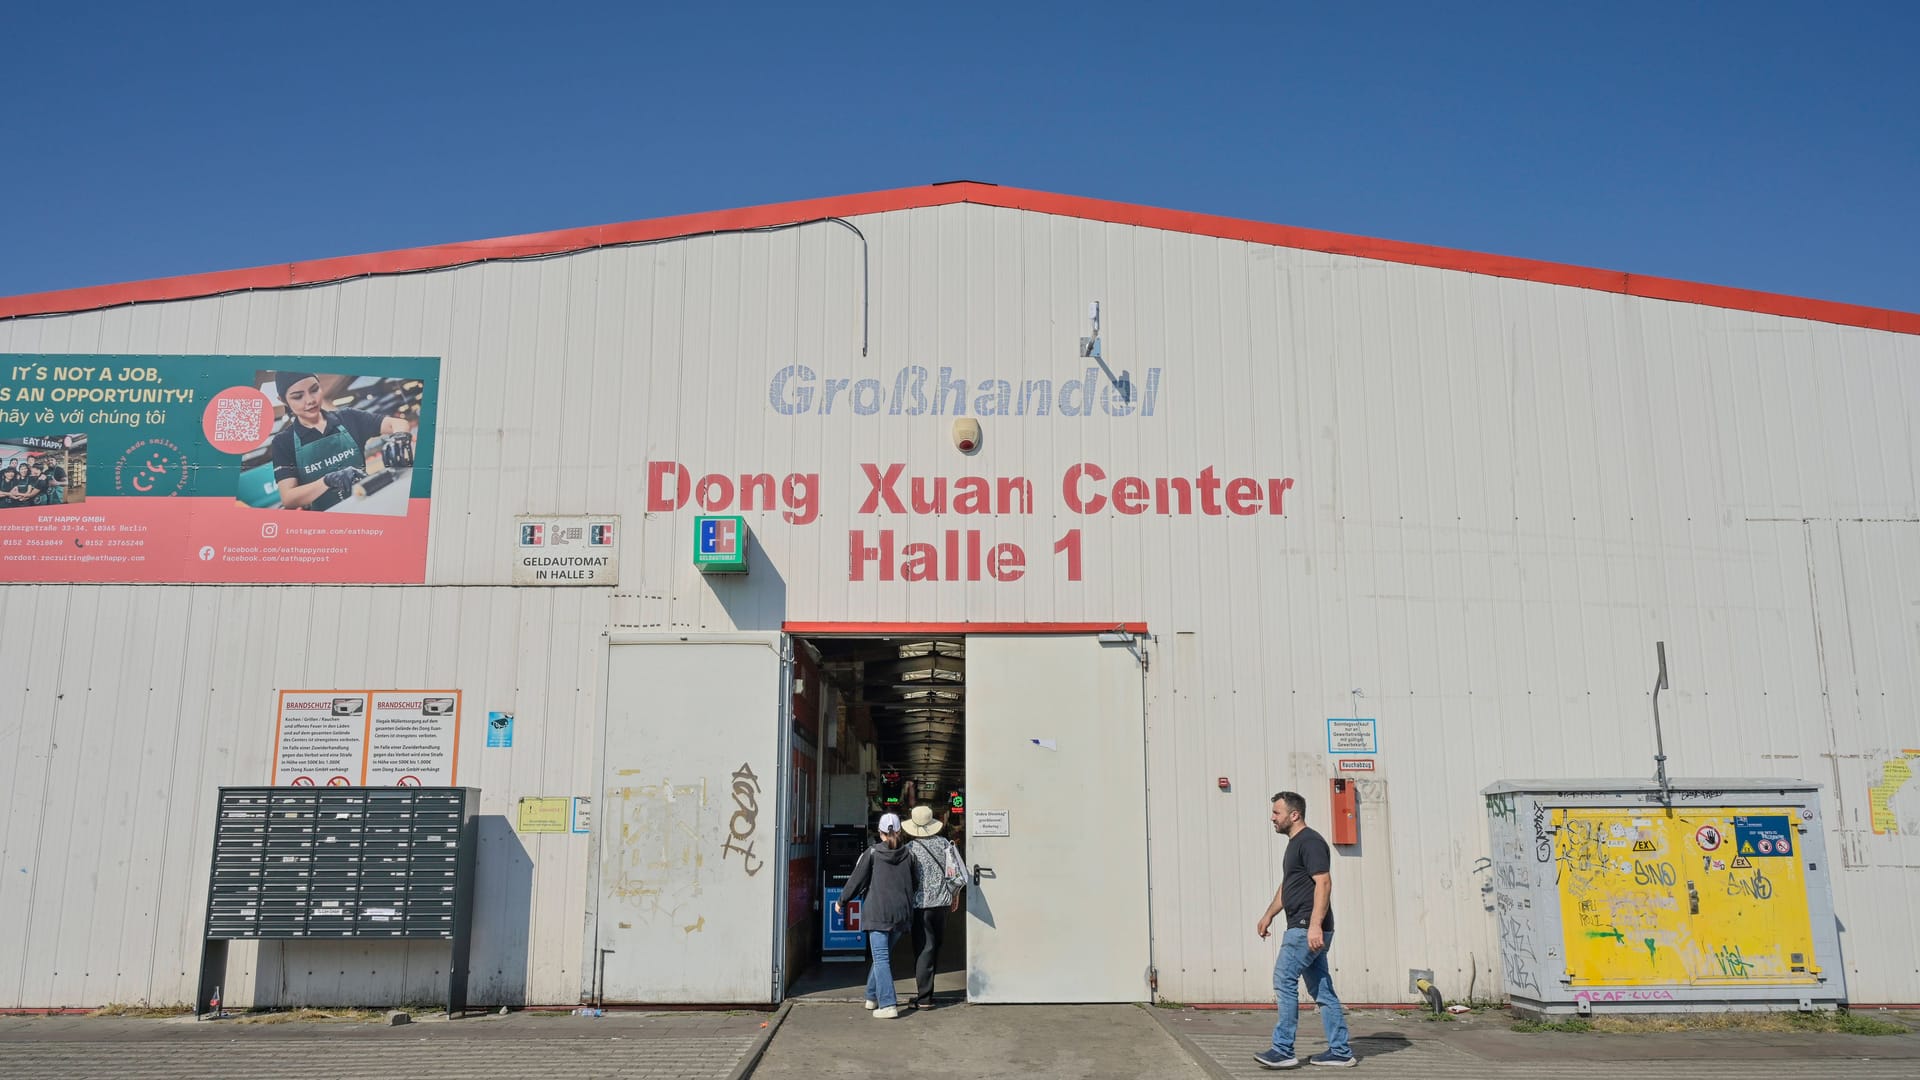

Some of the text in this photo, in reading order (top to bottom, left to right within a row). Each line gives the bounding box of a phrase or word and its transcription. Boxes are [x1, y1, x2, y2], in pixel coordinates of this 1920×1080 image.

[54, 367, 96, 381] NOT
[99, 367, 113, 381] A
[118, 367, 162, 384] JOB,
[0, 387, 194, 403] S AN OPPORTUNITY!
[769, 365, 1161, 417] Großhandel
[0, 407, 166, 427] hãy về với chúng tôi
[23, 436, 63, 450] EAT HAPPY
[304, 448, 354, 474] EAT HAPPY
[646, 461, 1295, 524] Dong Xuan Center
[523, 557, 608, 567] GELDAUTOMAT
[848, 528, 1082, 581] Halle 1
[536, 570, 594, 580] IN HALLE 3
[1638, 841, 1649, 849] EX
